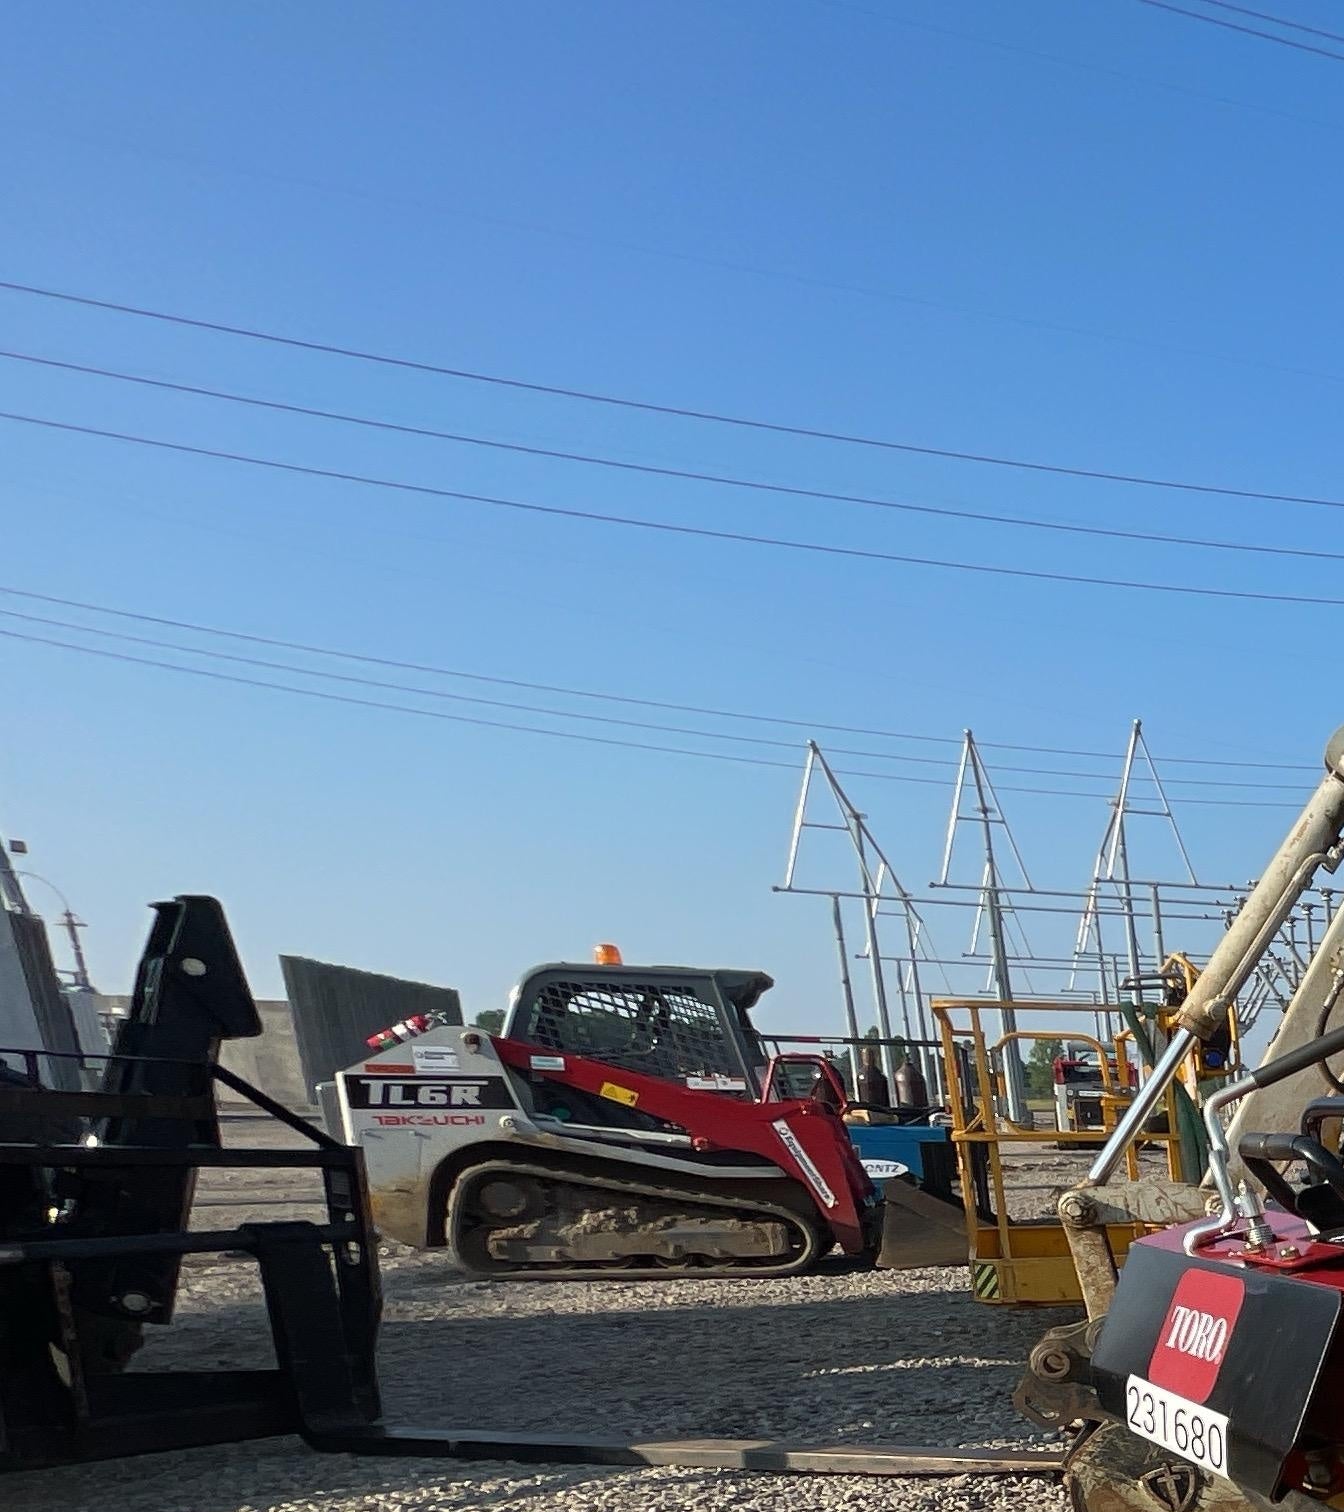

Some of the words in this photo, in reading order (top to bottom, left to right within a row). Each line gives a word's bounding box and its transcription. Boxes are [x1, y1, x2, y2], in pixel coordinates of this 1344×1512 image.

[360, 1079, 489, 1106] TL6R
[1165, 1305, 1228, 1364] TORO
[1128, 1386, 1223, 1469] 231680
